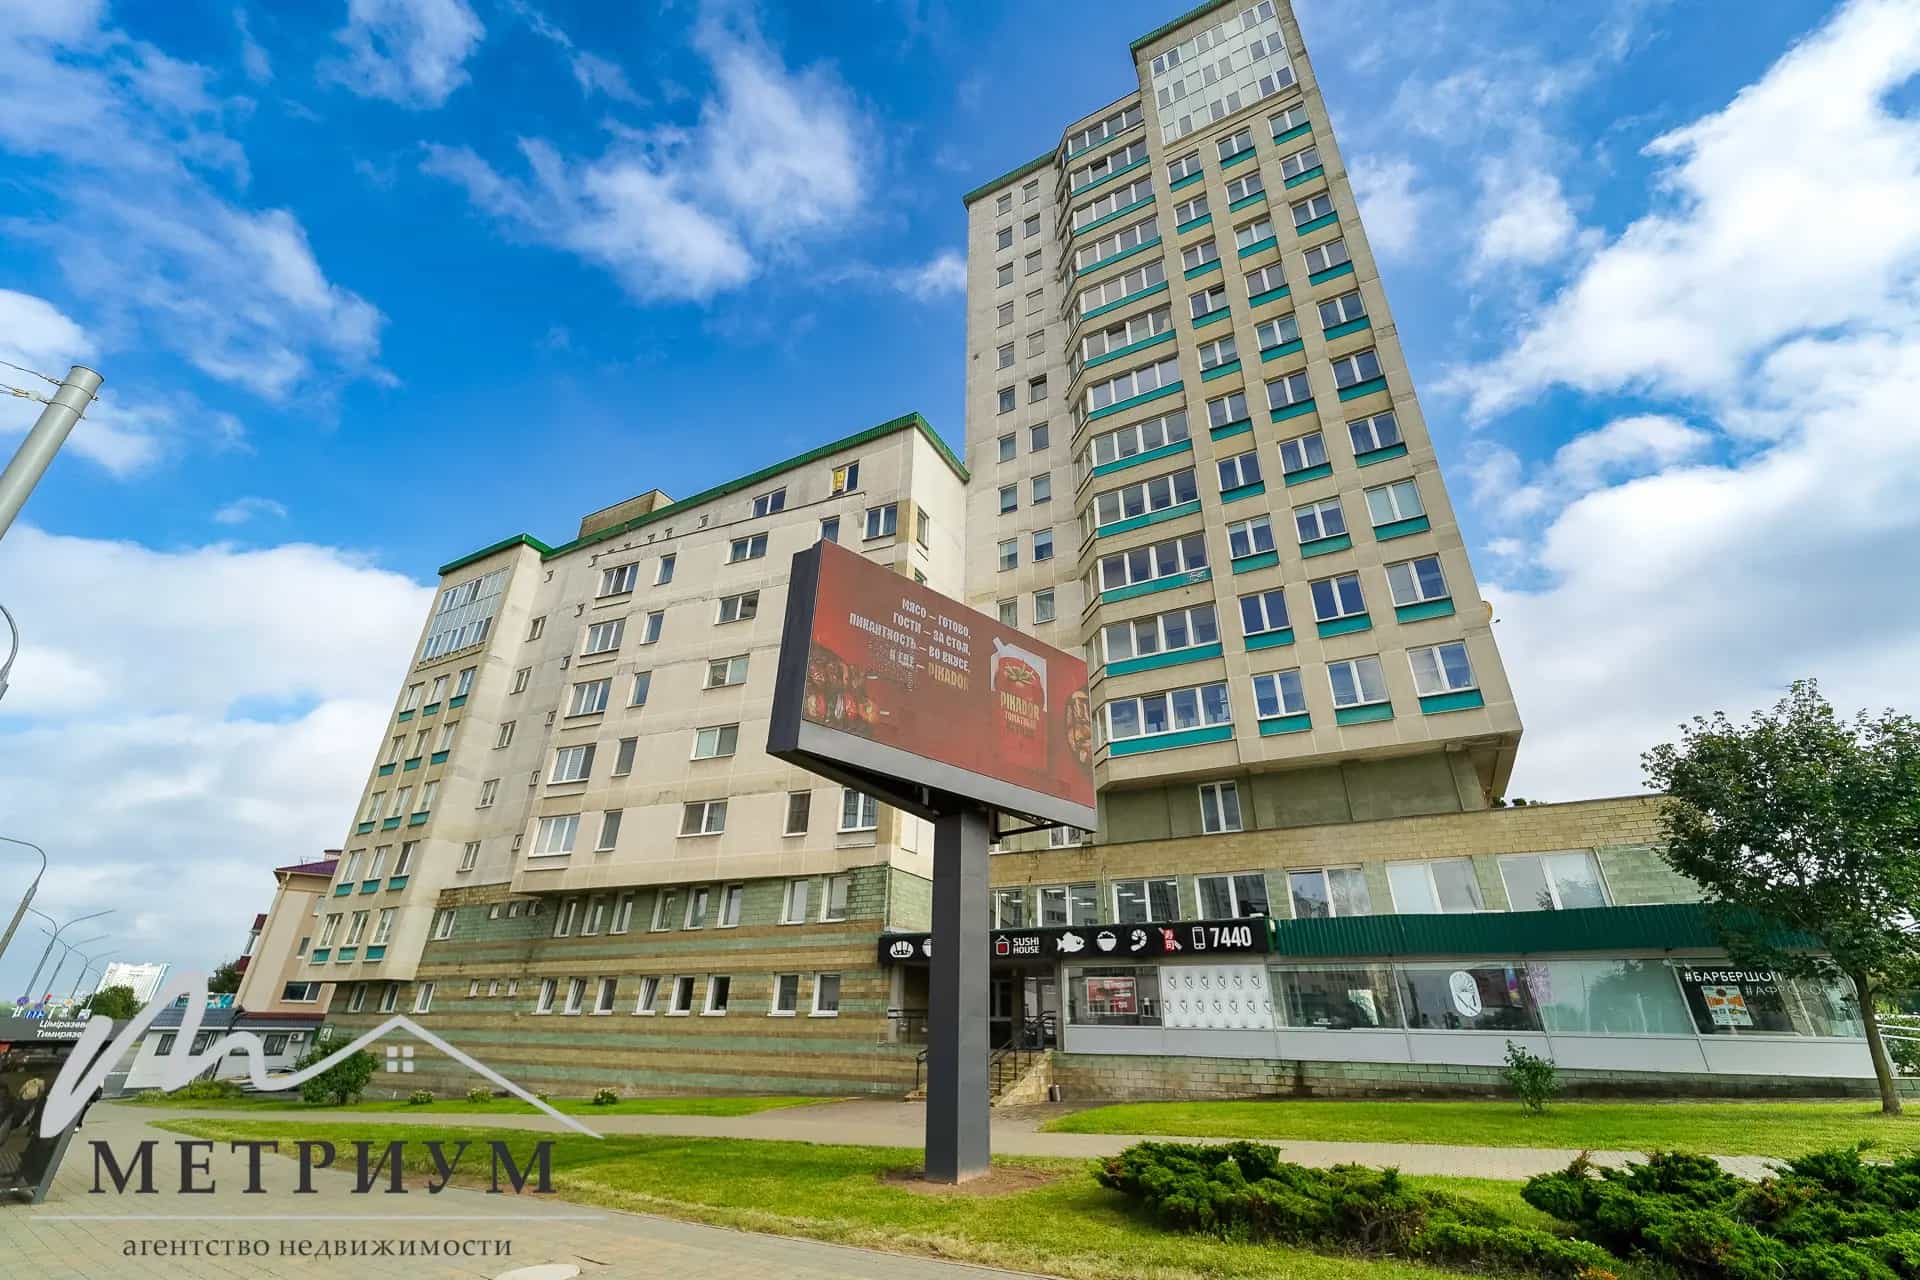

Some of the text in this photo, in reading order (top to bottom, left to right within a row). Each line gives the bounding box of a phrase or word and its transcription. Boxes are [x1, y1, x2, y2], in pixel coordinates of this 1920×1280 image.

[902, 598, 927, 618] МЯСО
[893, 612, 921, 633] ГОСТИ
[849, 612, 916, 649] ПИКАНТНОСТЬ
[928, 646, 941, 660] ВО
[1013, 937, 1040, 946] SUSHI
[1210, 926, 1252, 948] 7440
[1013, 945, 1040, 954] HOUSE
